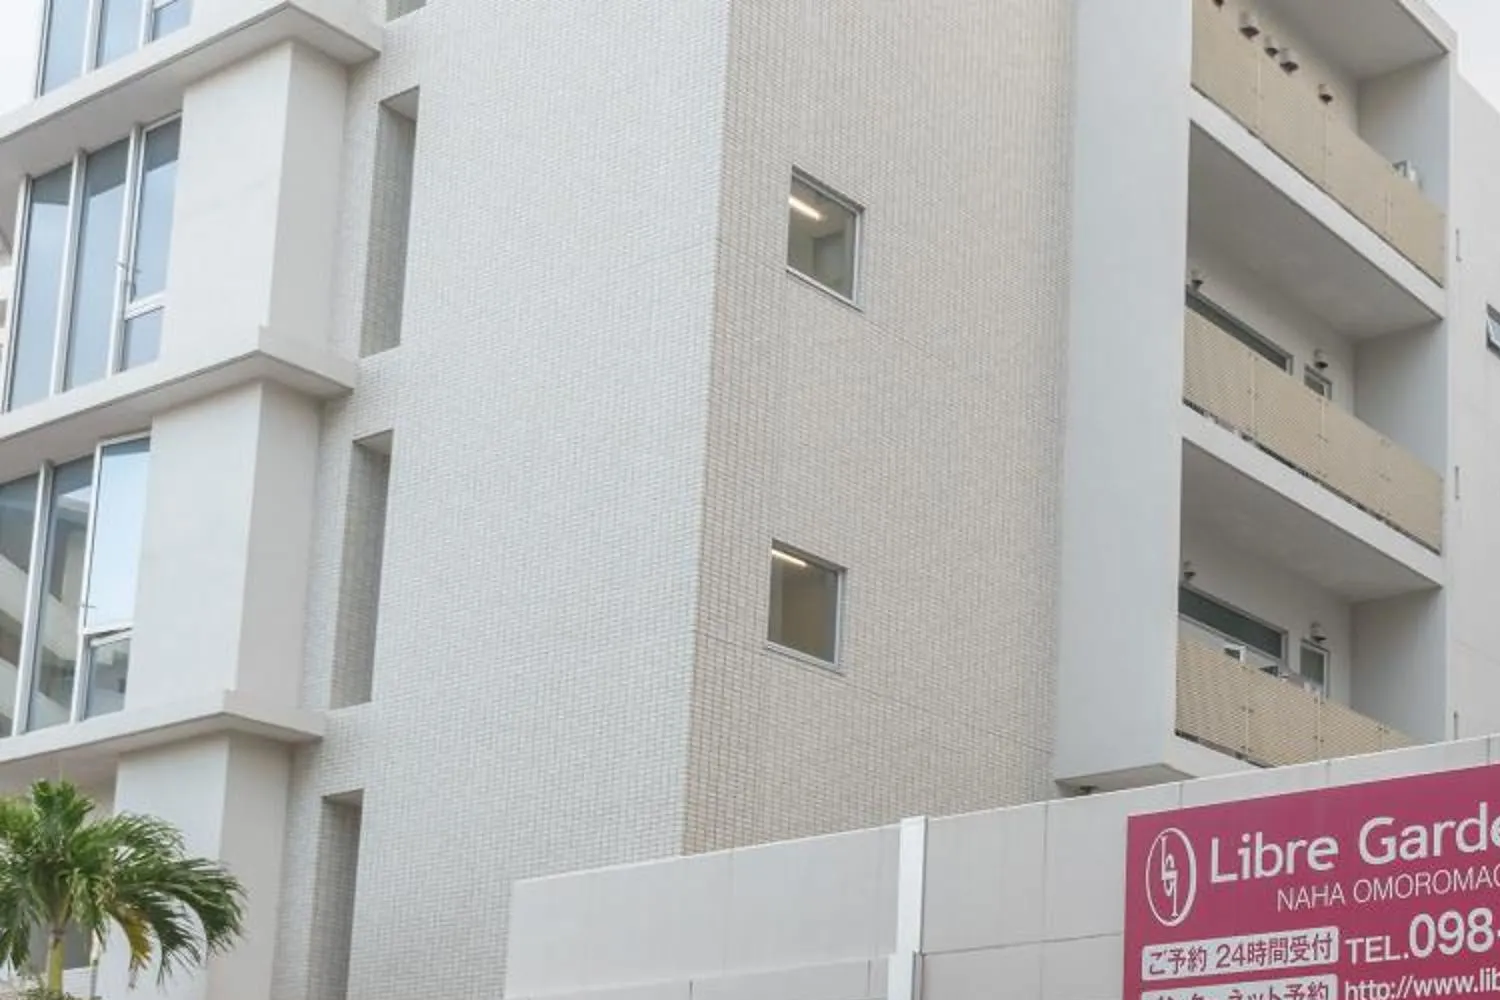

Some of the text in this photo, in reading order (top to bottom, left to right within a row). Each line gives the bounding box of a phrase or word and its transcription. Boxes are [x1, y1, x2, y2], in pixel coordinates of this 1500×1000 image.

[1211, 831, 1340, 884] Libre
[1277, 877, 1346, 912] NAHA
[1146, 932, 1332, 976] ご予約 24時間受付
